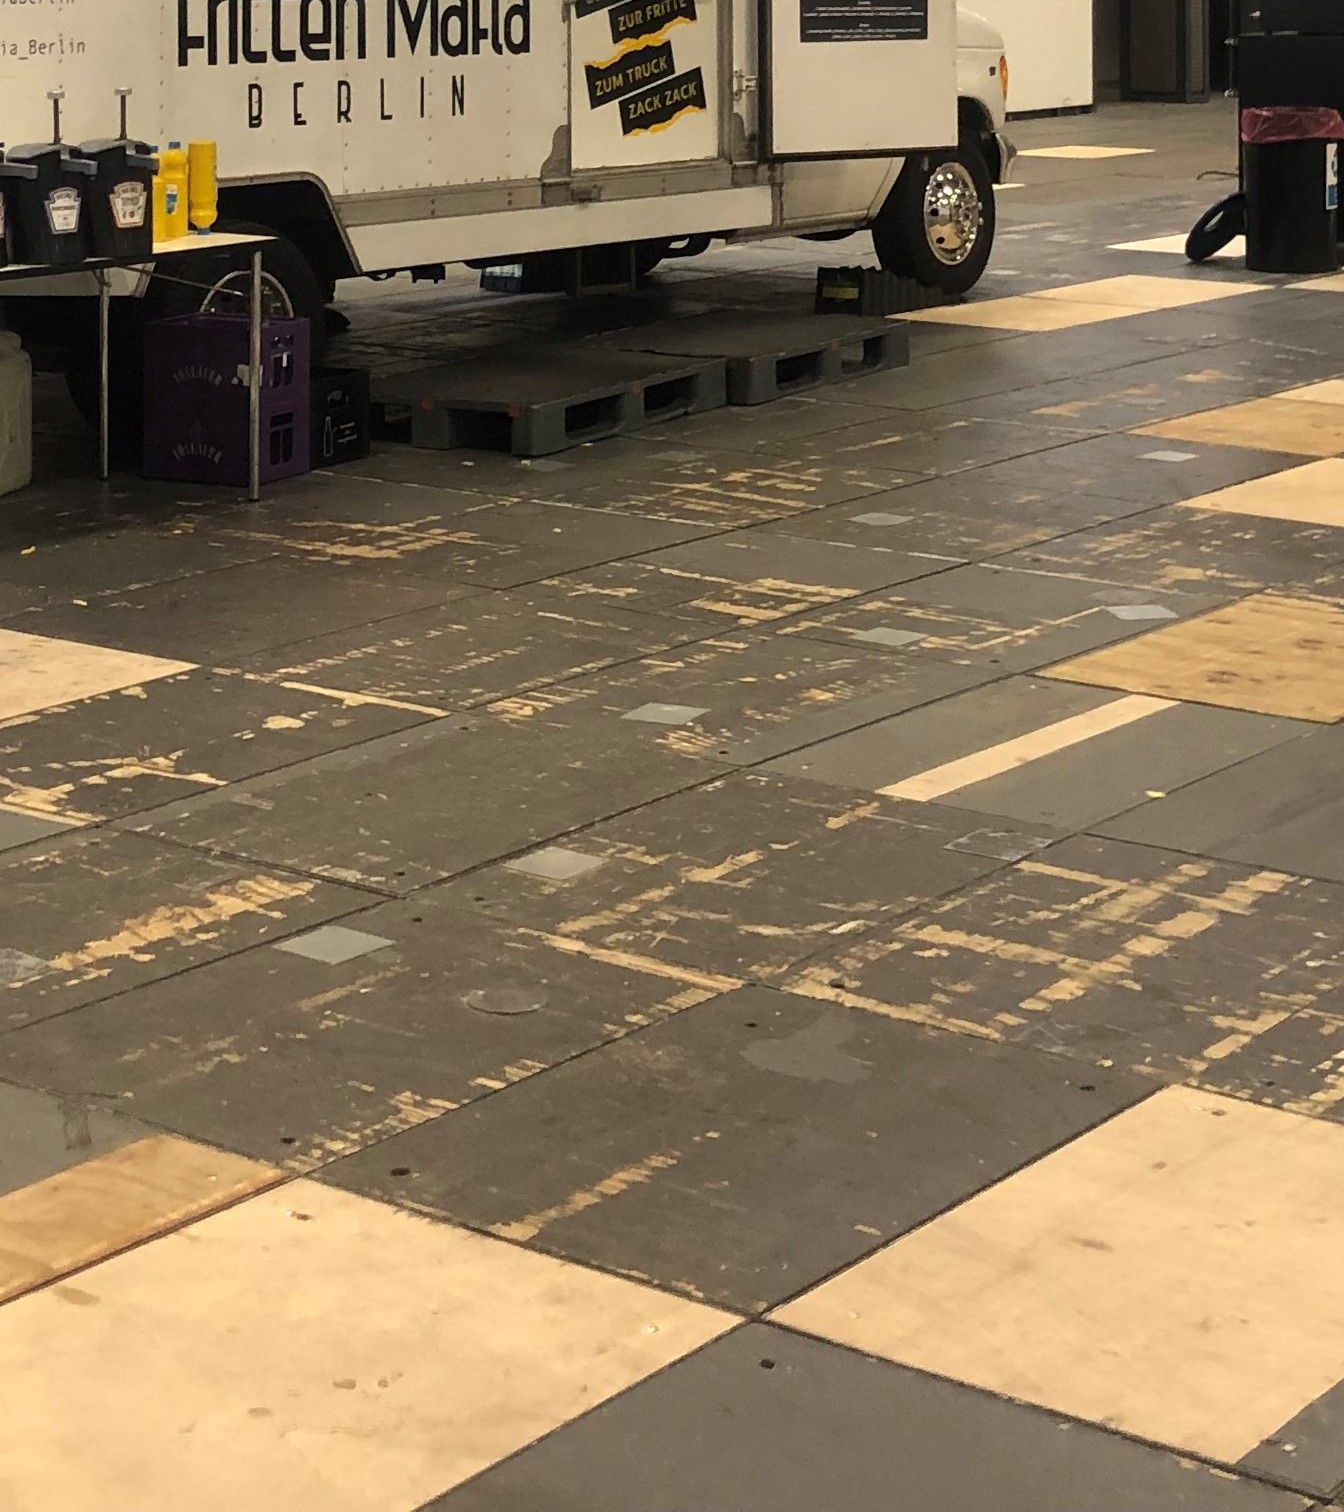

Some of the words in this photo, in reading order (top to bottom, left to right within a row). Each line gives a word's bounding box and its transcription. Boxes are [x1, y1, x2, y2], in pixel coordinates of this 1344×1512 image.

[617, 10, 643, 32] ZUR
[594, 73, 624, 96] ZUM
[626, 55, 669, 84] TRUCK
[247, 74, 465, 129] BERLIN
[627, 95, 663, 120] ZACK
[664, 81, 698, 105] ZACK
